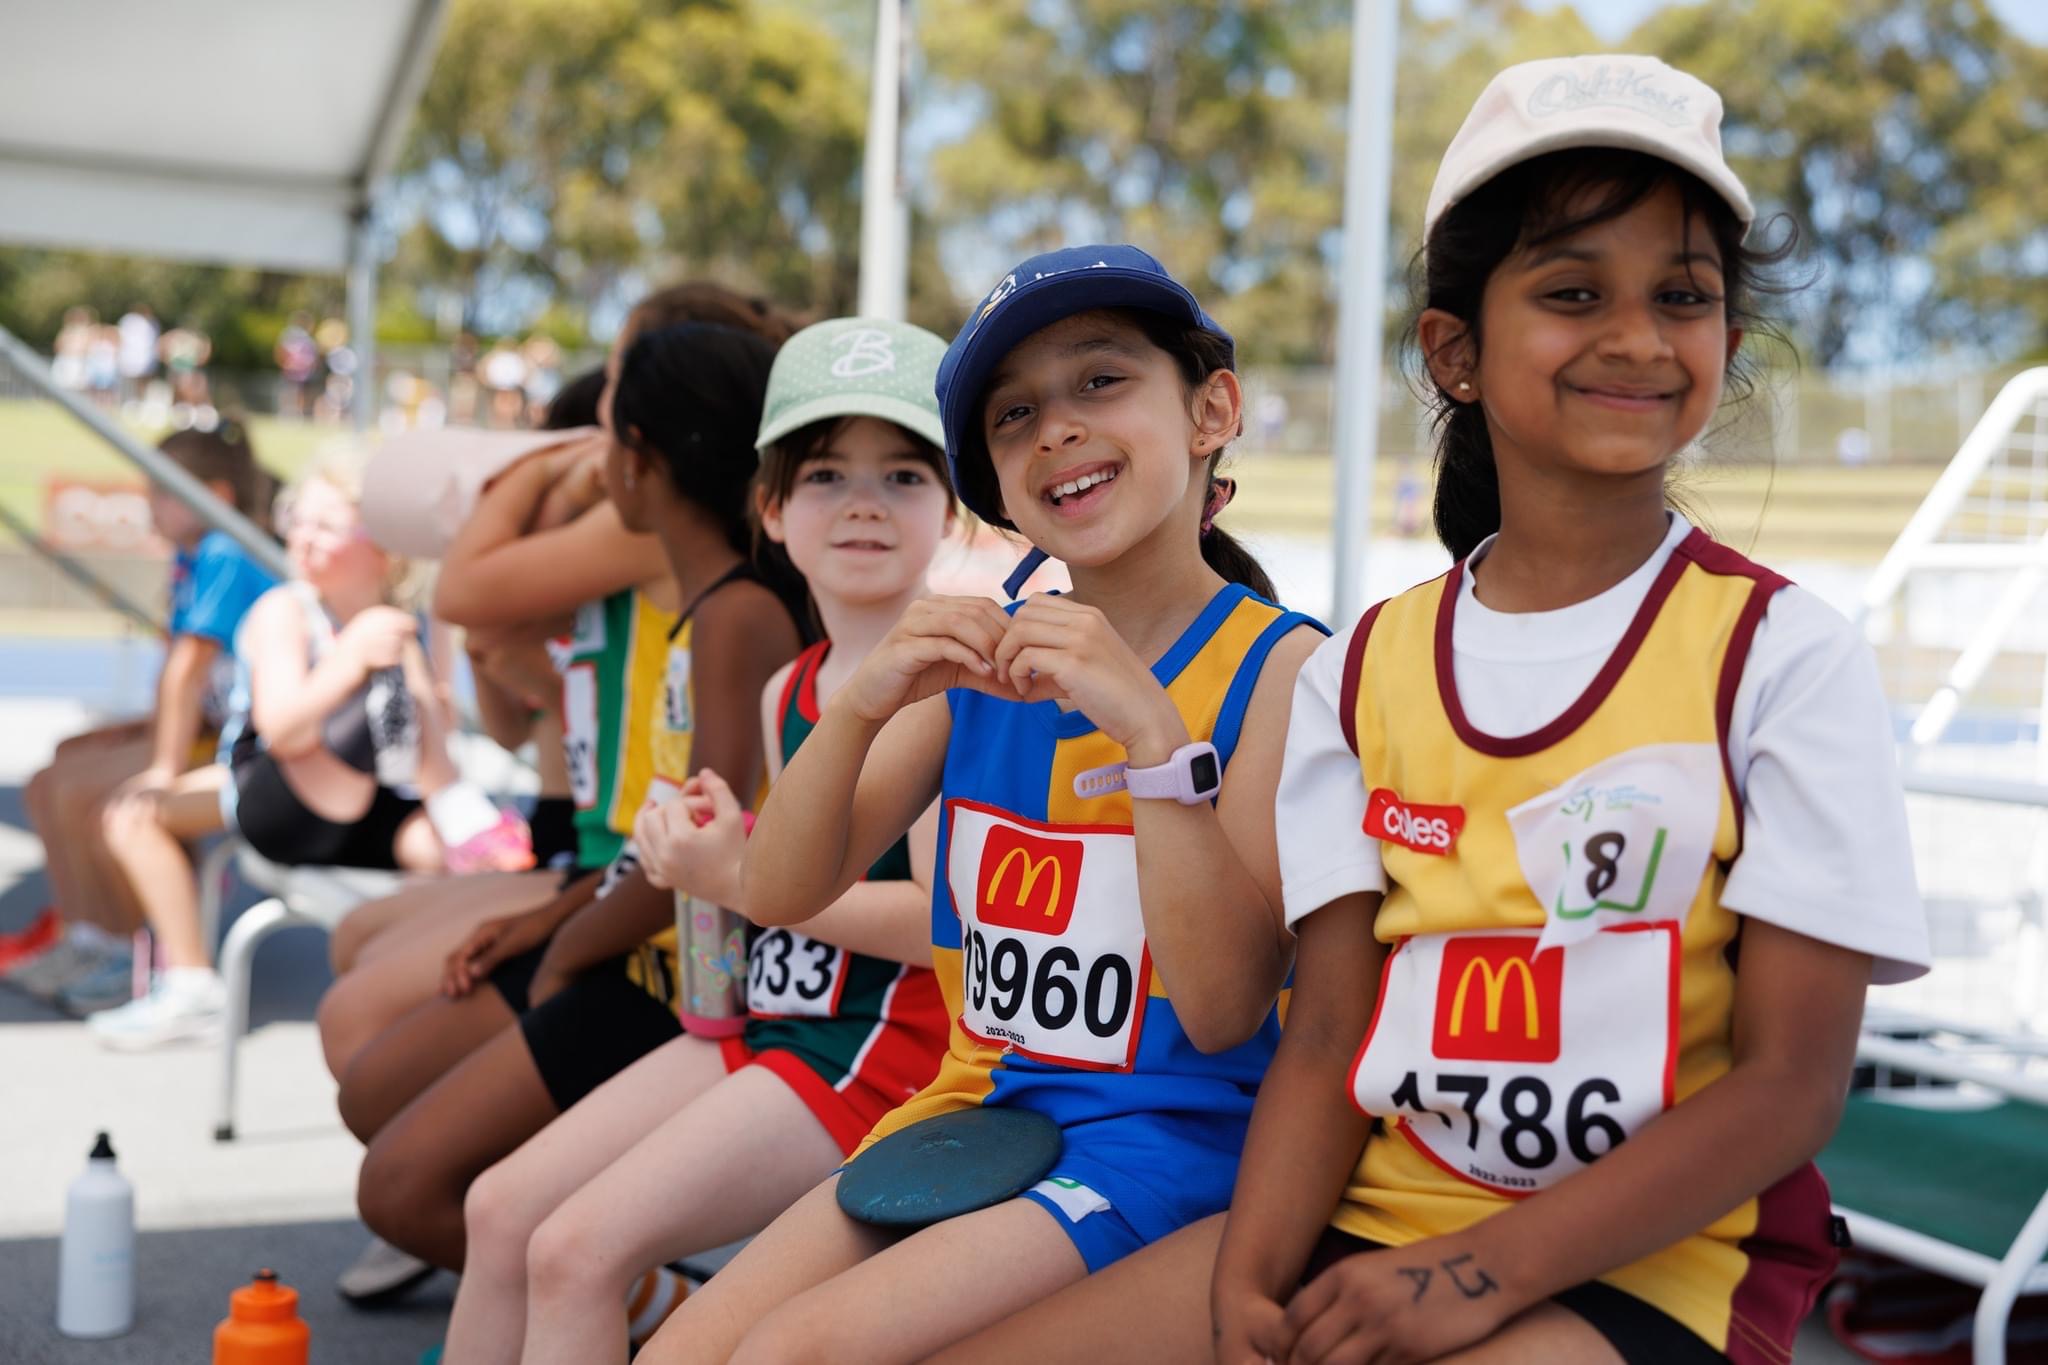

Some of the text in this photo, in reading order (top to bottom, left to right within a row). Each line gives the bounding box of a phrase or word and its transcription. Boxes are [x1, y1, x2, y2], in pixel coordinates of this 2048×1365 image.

[830, 328, 897, 379] B
[1583, 831, 1626, 899] 8
[965, 922, 1133, 1039] 19960
[985, 1025, 1026, 1045] 2022-2023
[1391, 1071, 1627, 1169] 1786
